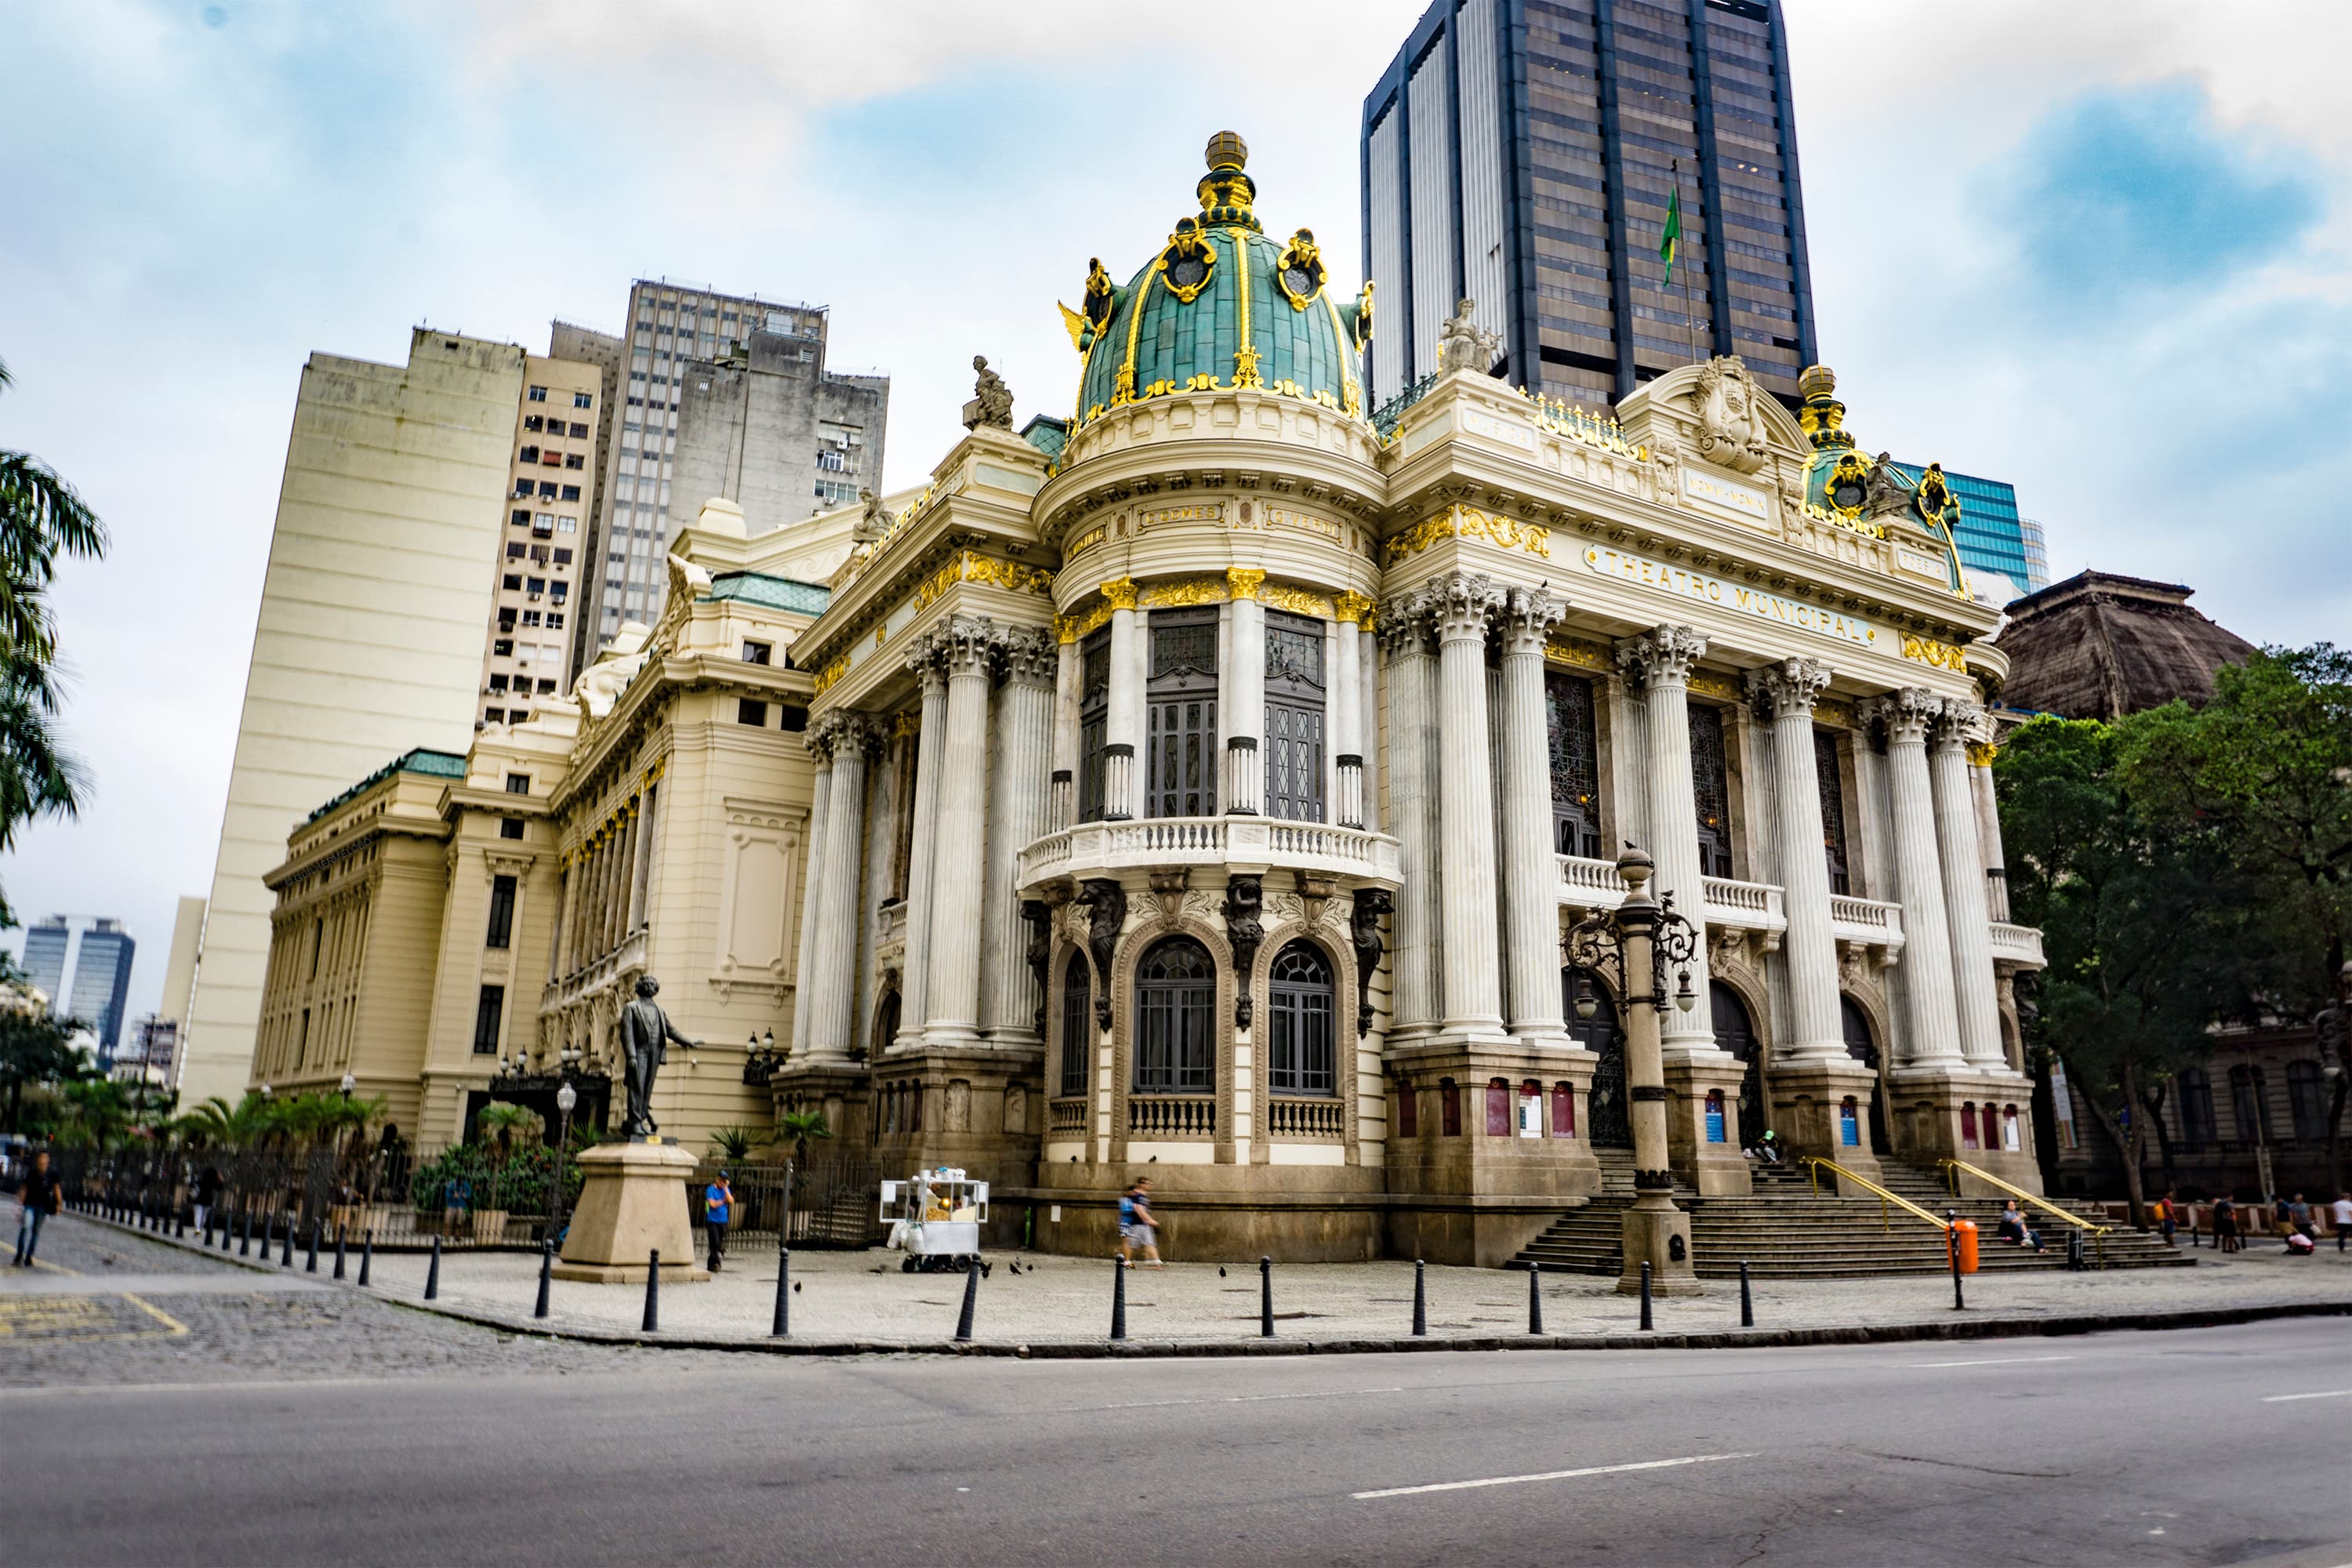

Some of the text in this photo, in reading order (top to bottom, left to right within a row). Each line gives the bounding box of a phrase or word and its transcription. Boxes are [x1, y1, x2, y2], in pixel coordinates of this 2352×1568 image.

[1160, 506, 1215, 521] GOMES
[1291, 514, 1337, 535] VERDI
[1606, 551, 1860, 640] THEATRO MUNICIPAL
